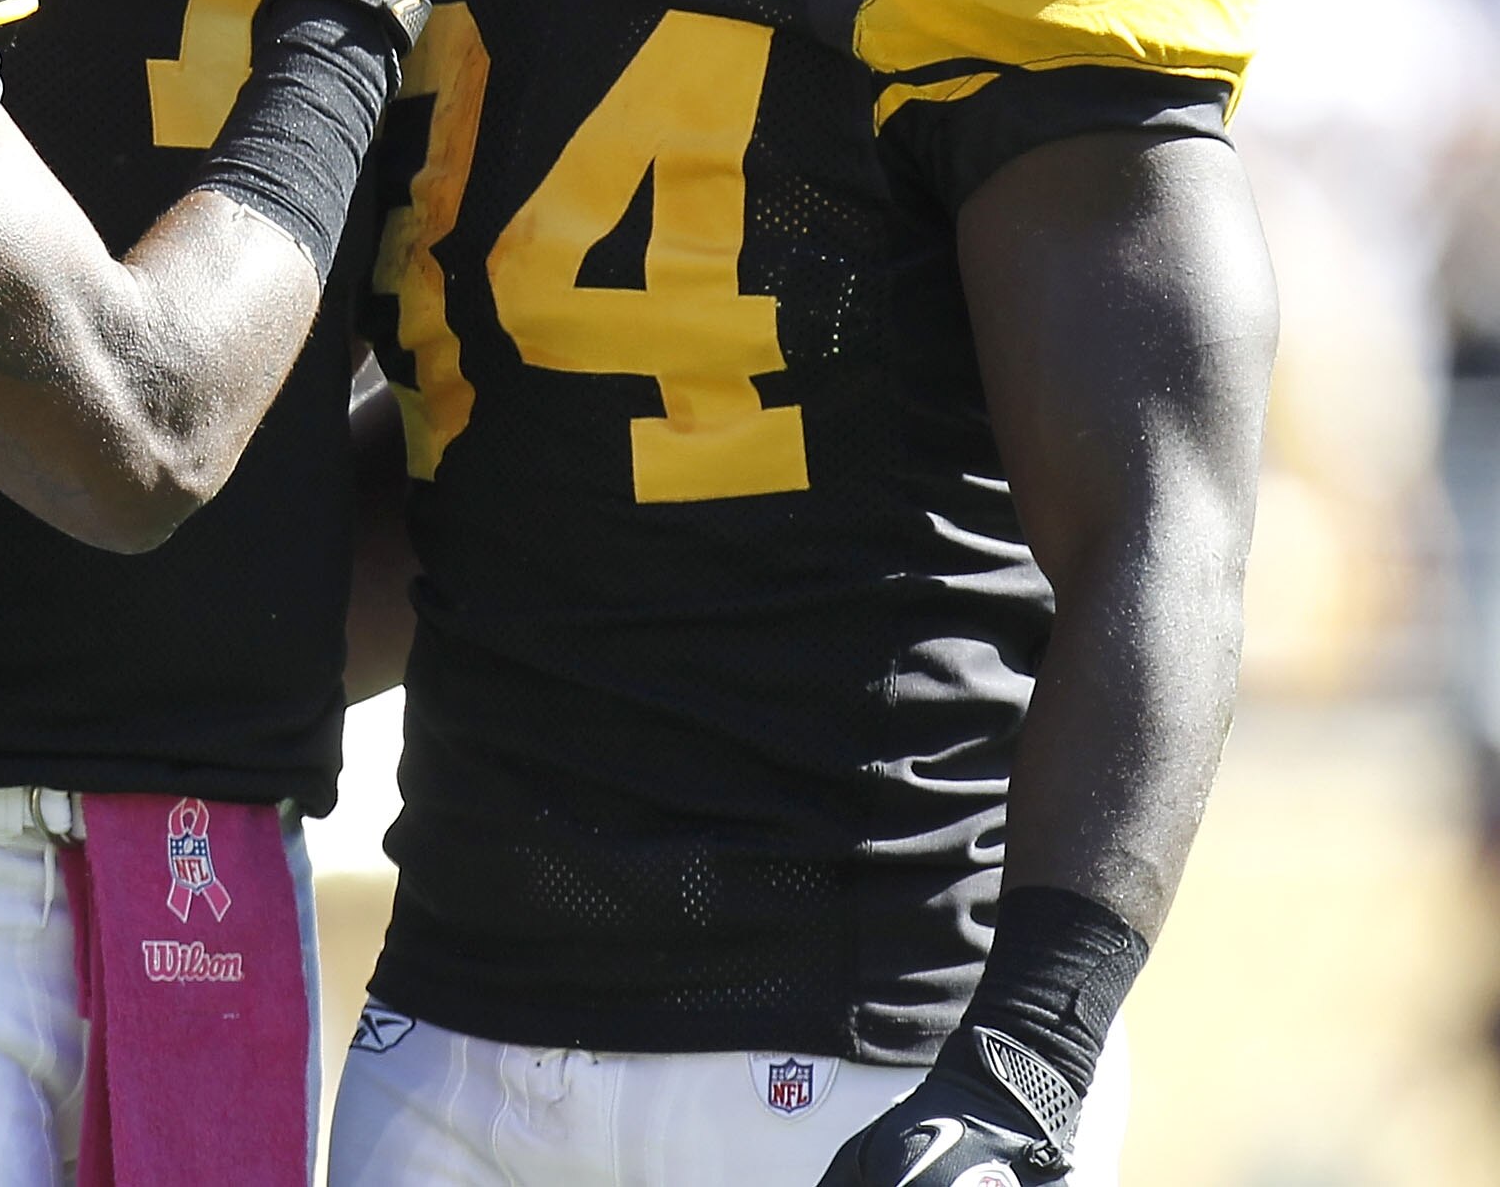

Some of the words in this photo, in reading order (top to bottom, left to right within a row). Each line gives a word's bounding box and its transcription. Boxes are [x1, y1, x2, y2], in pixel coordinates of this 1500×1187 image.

[175, 858, 209, 886] NFL
[142, 940, 244, 982] Wilson
[771, 1083, 808, 1108] NFL
